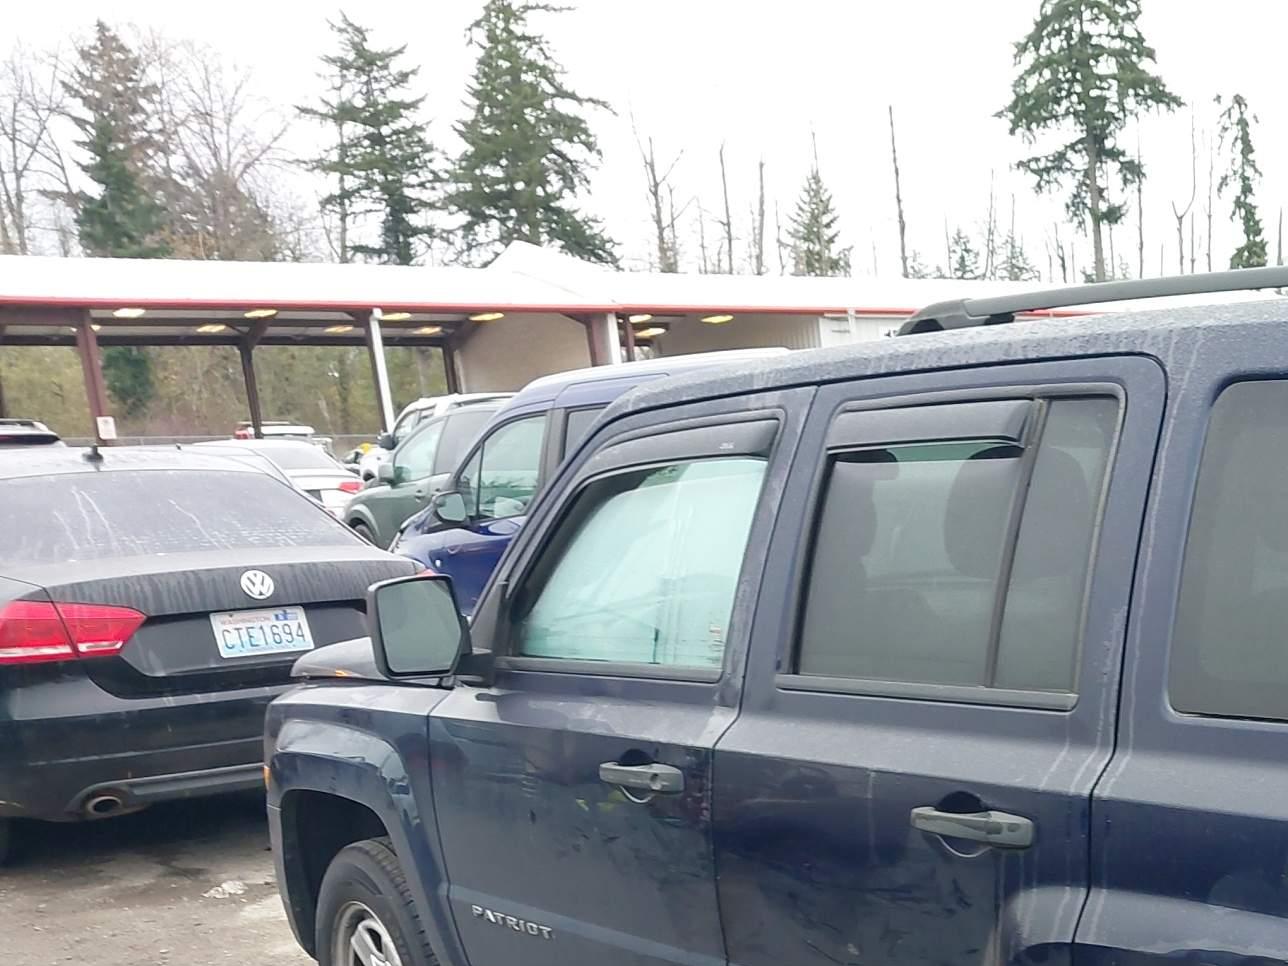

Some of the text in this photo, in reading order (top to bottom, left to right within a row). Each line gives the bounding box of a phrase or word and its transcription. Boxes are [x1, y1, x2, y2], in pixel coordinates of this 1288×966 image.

[241, 570, 275, 600] VW
[221, 621, 307, 650] CTE1694
[471, 904, 553, 940] PATRIOT
